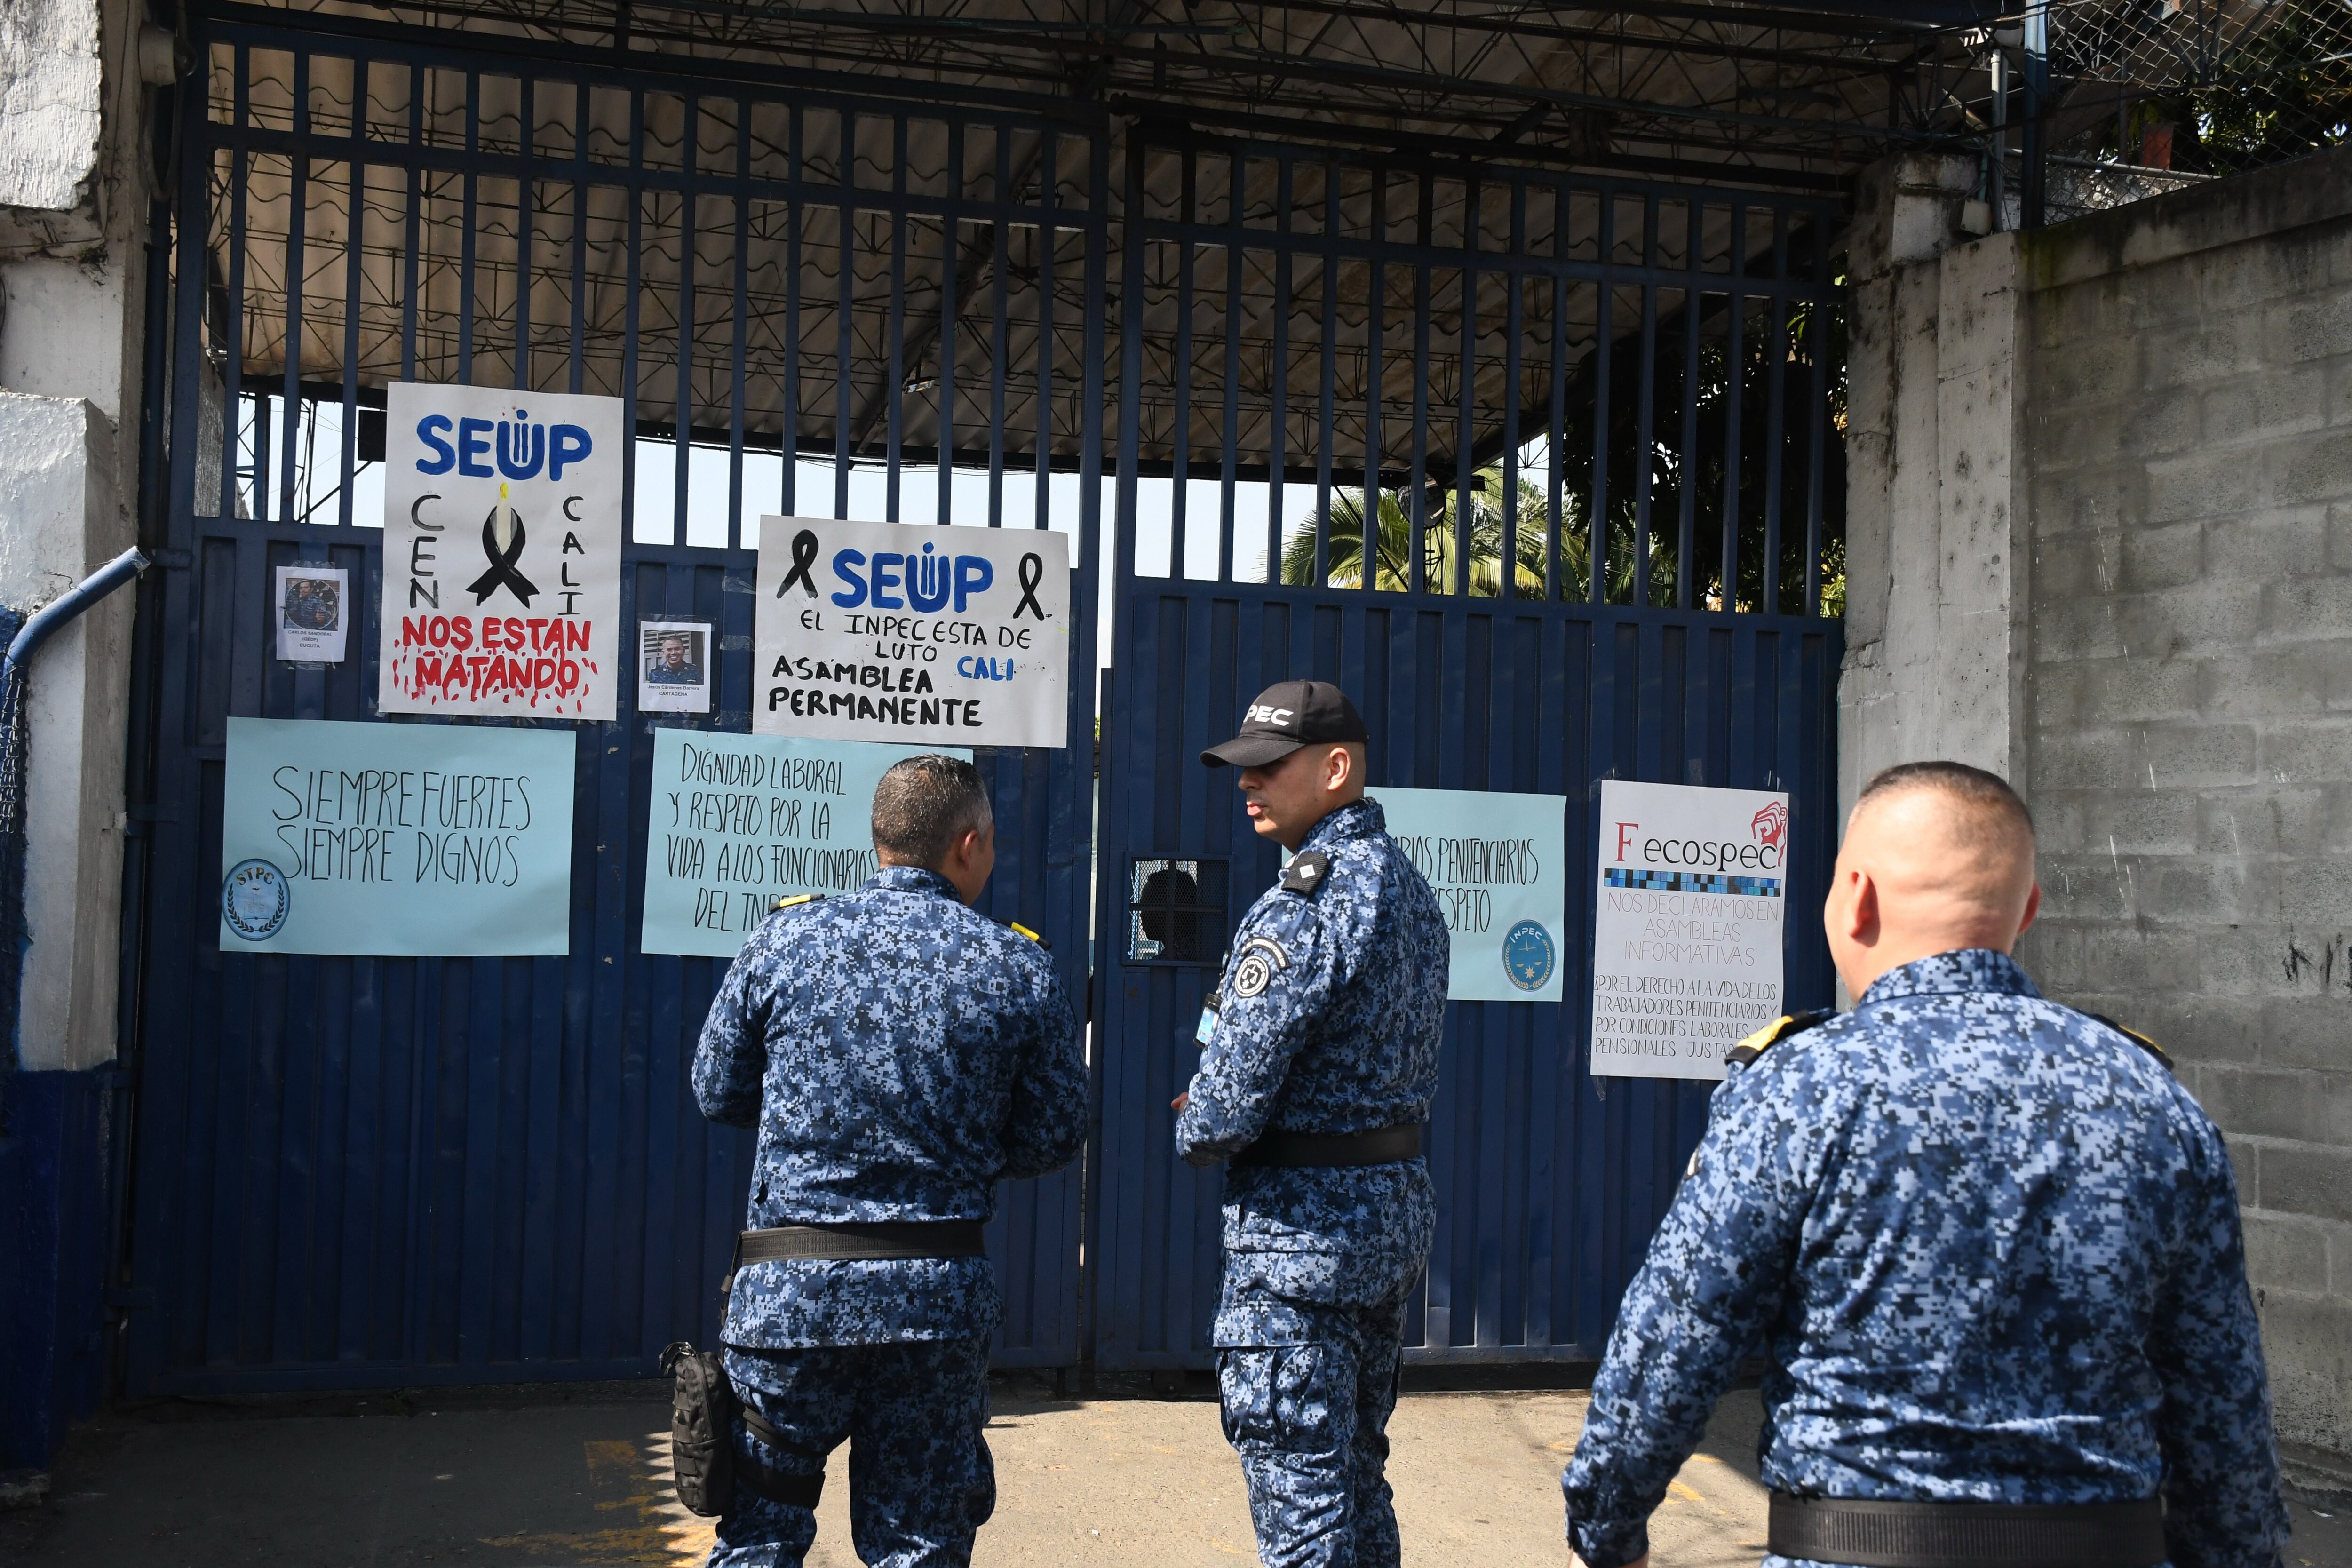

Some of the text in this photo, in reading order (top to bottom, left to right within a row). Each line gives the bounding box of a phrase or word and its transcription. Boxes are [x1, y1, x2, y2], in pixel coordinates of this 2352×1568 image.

[557, 496, 585, 615] CALI
[403, 615, 591, 652] NOS ESTAN
[801, 610, 1031, 649] EL INPEC ESTA DE
[875, 640, 937, 662] LUTO
[957, 656, 1014, 681] CALI
[415, 655, 579, 692] MATANDO
[772, 655, 933, 694] ASAMBLEA
[769, 687, 983, 727] PERMANENTE
[682, 743, 846, 795] DIGNIDAD LABORAL
[272, 766, 531, 830] SIEMPRE FUERTES
[667, 792, 829, 840] Y RESPETO POR LA
[277, 824, 519, 887] SIEMPRE DIGNOS
[667, 834, 705, 879] VIDA
[771, 845, 875, 891] FUNCIONARIOS
[1438, 838, 1539, 885] PENITENCIARIOS
[237, 867, 274, 885] STPC
[695, 887, 733, 932] DEL
[1430, 886, 1491, 933] ESPETO
[1608, 892, 1778, 921] NOS DECLARAMOS EN
[1643, 918, 1741, 942] ASAMBLEAS
[1625, 941, 1754, 966] INFORMATIVAS
[1620, 976, 1633, 992] EL
[1636, 976, 1684, 995] DERECHO
[1687, 979, 1695, 995] A
[1698, 979, 1712, 996] LA
[1715, 980, 1740, 998] VIDA
[1742, 982, 1756, 999] DE
[1757, 983, 1776, 1000] LOS
[1595, 995, 1778, 1020] TRABAJADORES PENITENCIARIOS Y
[1596, 1017, 1616, 1033] POR
[1619, 1018, 1686, 1036] CONDICIONES
[1691, 1020, 1749, 1039] LABORALES
[1596, 1037, 1676, 1057] PENSIONALES
